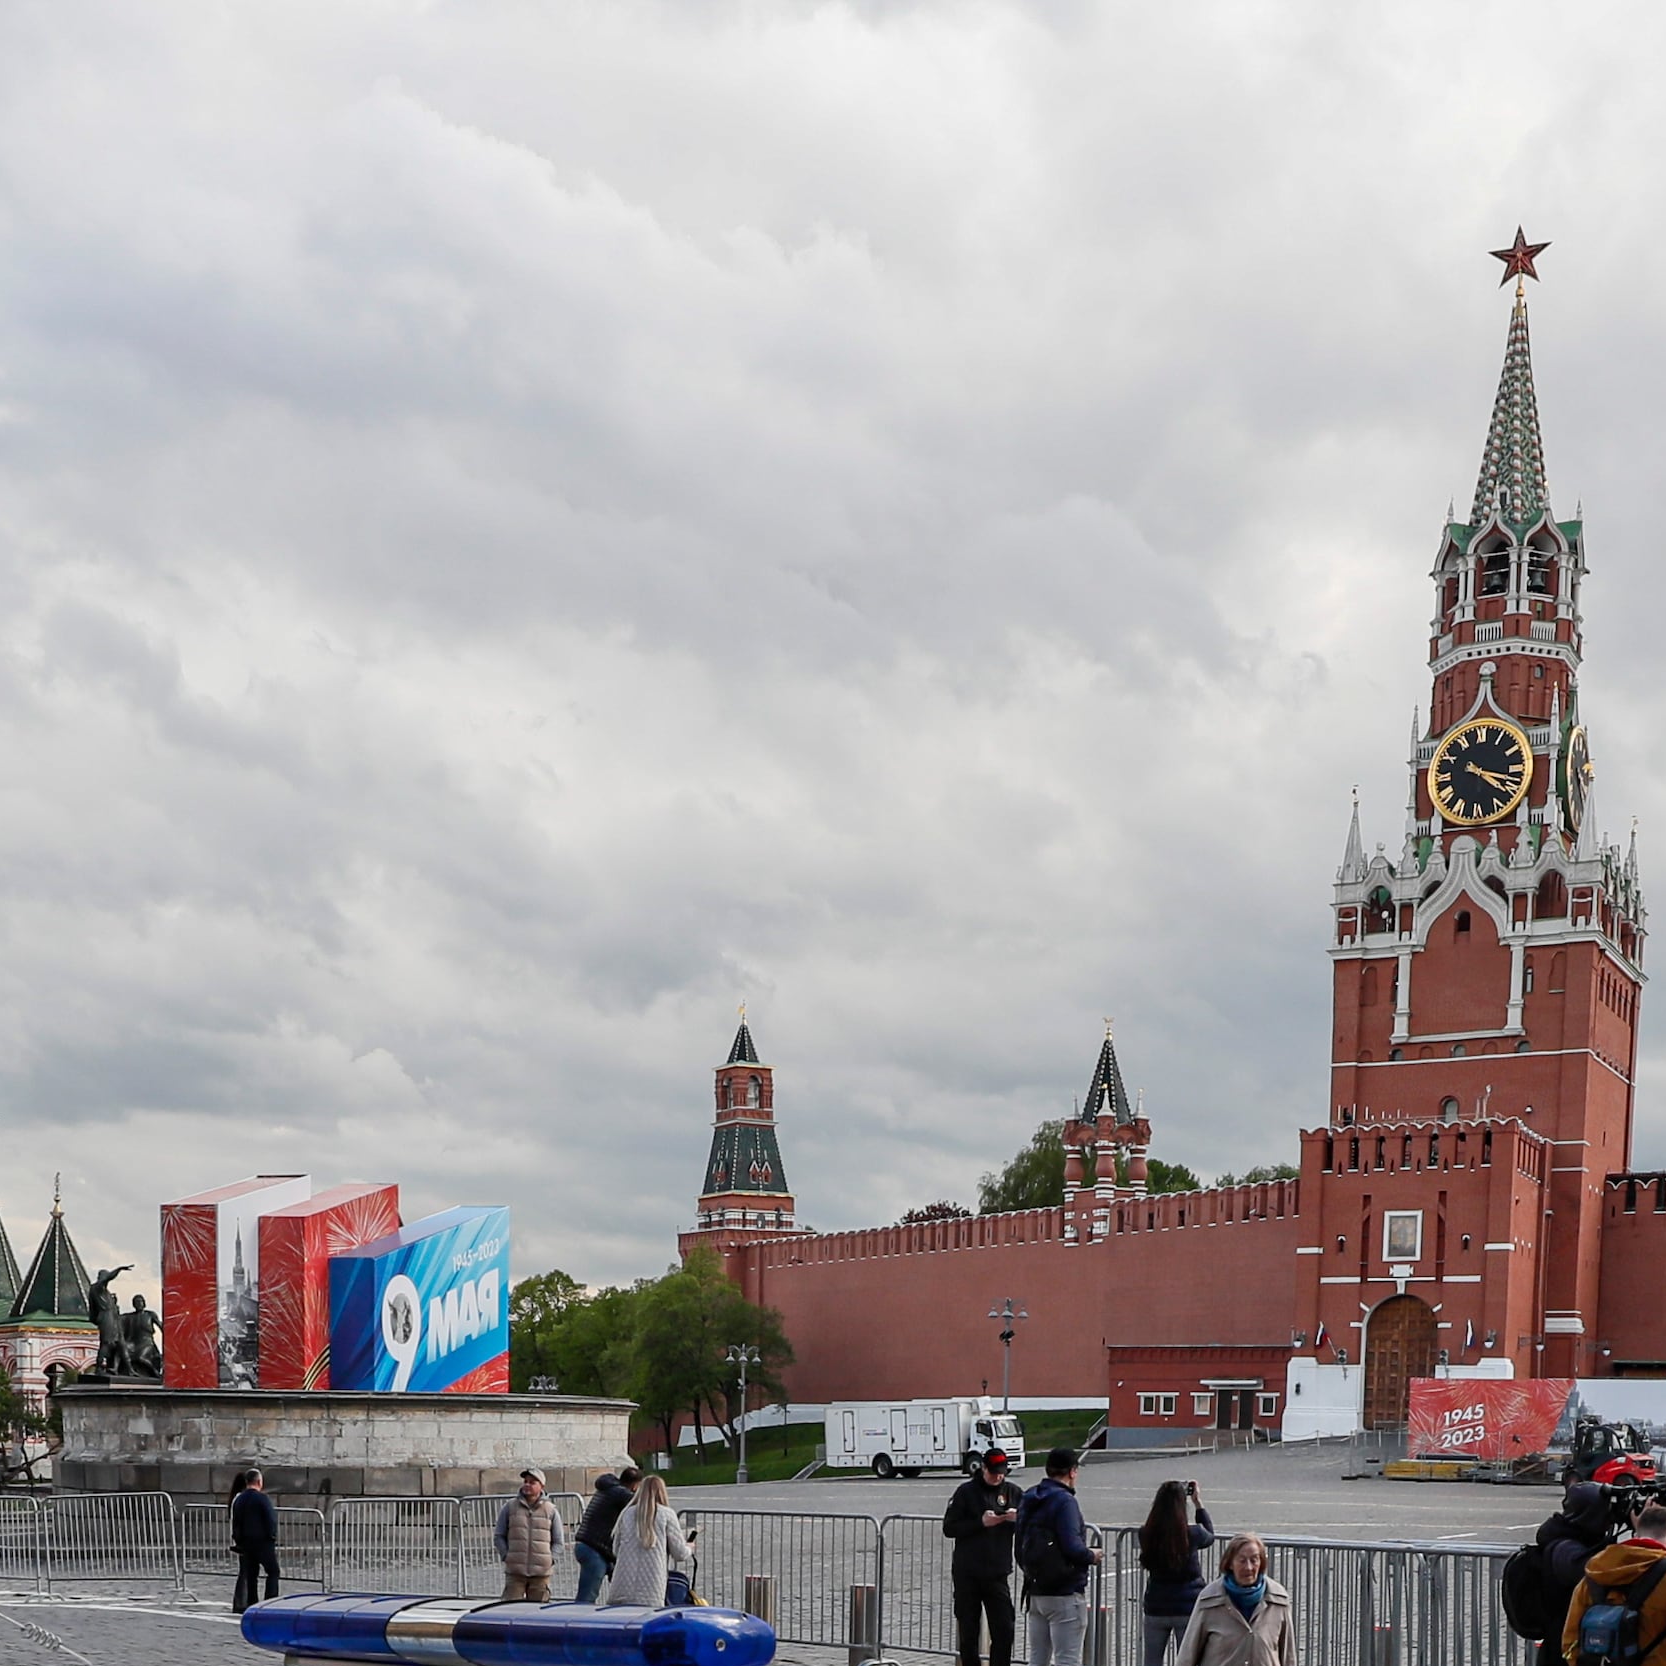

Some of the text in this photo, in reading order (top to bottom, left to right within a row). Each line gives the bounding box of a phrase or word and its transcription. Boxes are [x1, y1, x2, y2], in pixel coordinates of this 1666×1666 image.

[382, 1268, 500, 1393] 9 МАЯ
[1443, 1403, 1485, 1426] 1945
[1441, 1425, 1485, 1448] 2023
